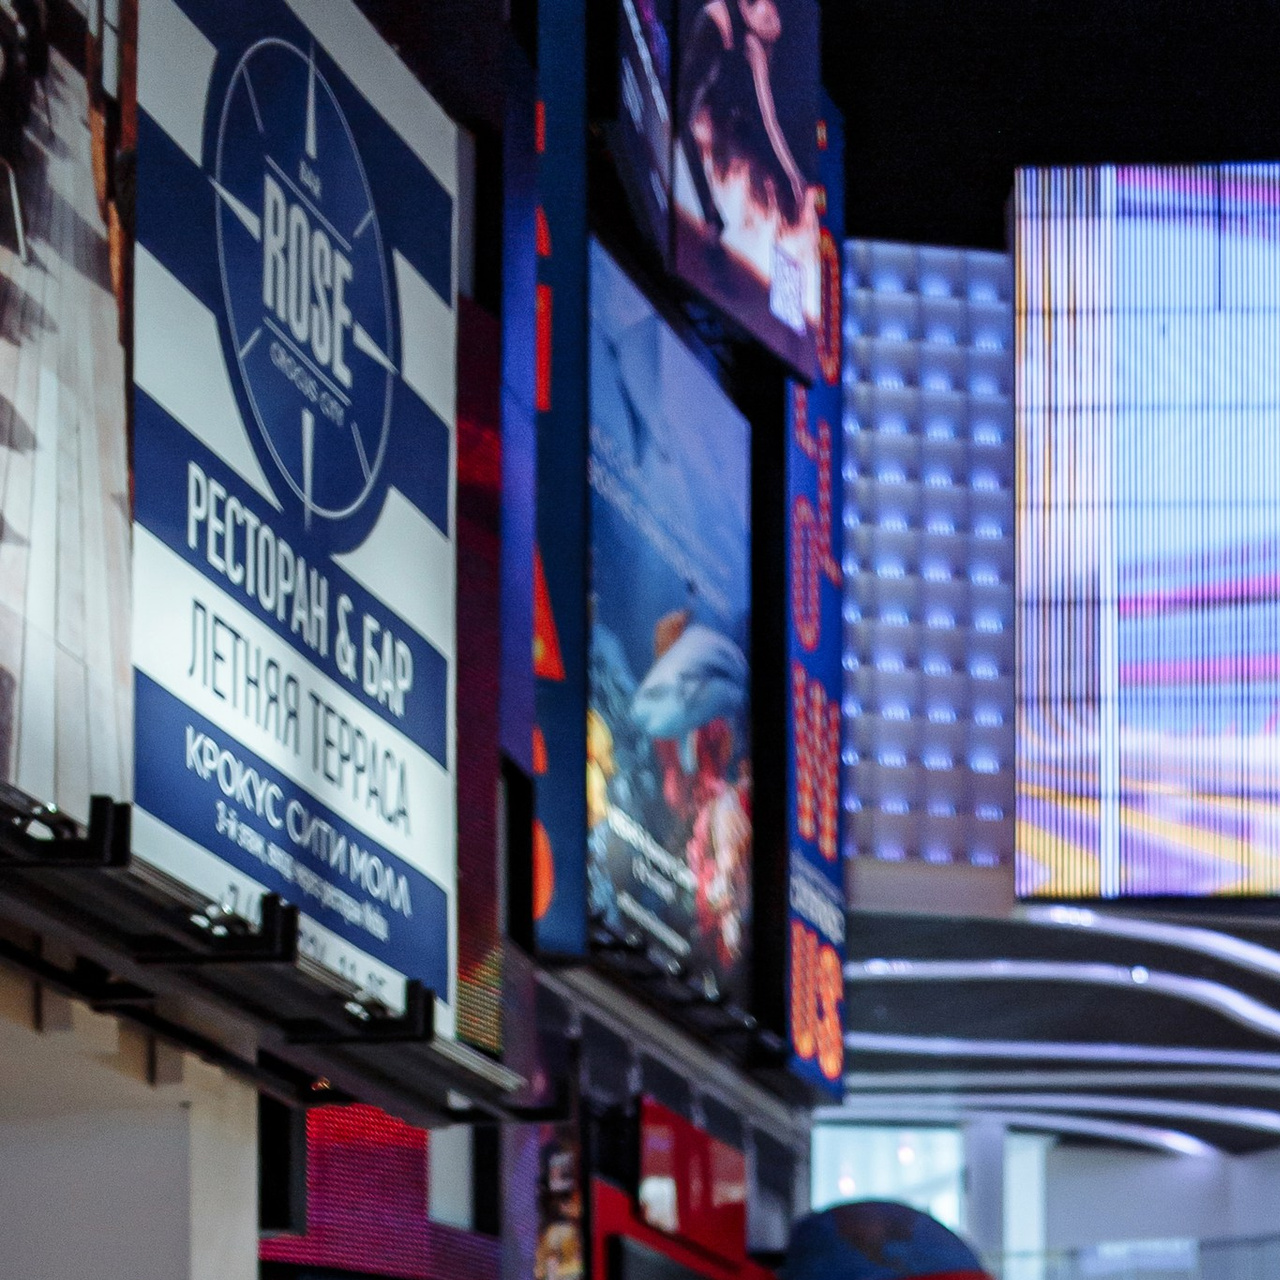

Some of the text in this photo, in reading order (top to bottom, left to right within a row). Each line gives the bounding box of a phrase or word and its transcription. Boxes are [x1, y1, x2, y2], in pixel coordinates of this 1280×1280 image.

[264, 172, 353, 389] ROSE
[186, 460, 413, 718] РЕСТОРАН & БАР
[185, 724, 285, 830] КРОКУС
[286, 800, 348, 876] СИТИ
[350, 842, 412, 919] МОЛЛ
[187, 595, 412, 837] ЛЕТНЯЯ ТЕРРАСА
